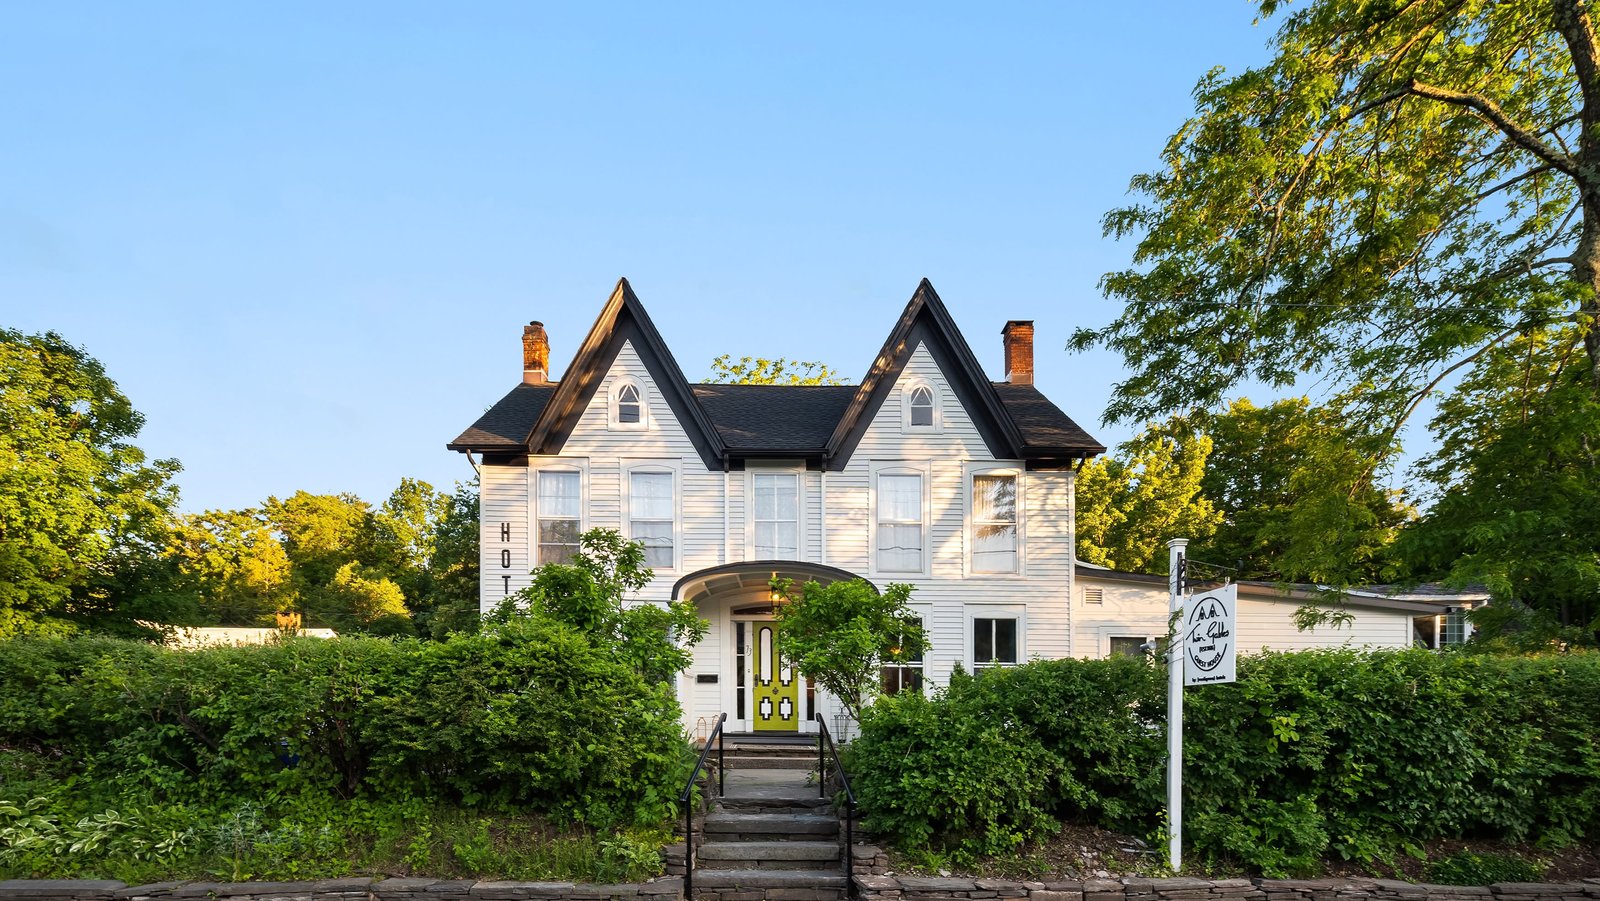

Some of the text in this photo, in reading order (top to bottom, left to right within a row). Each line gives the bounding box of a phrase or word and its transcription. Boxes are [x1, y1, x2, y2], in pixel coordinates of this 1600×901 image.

[1206, 621, 1229, 644] Gables
[1194, 652, 1221, 668] GUEST HOUSE
